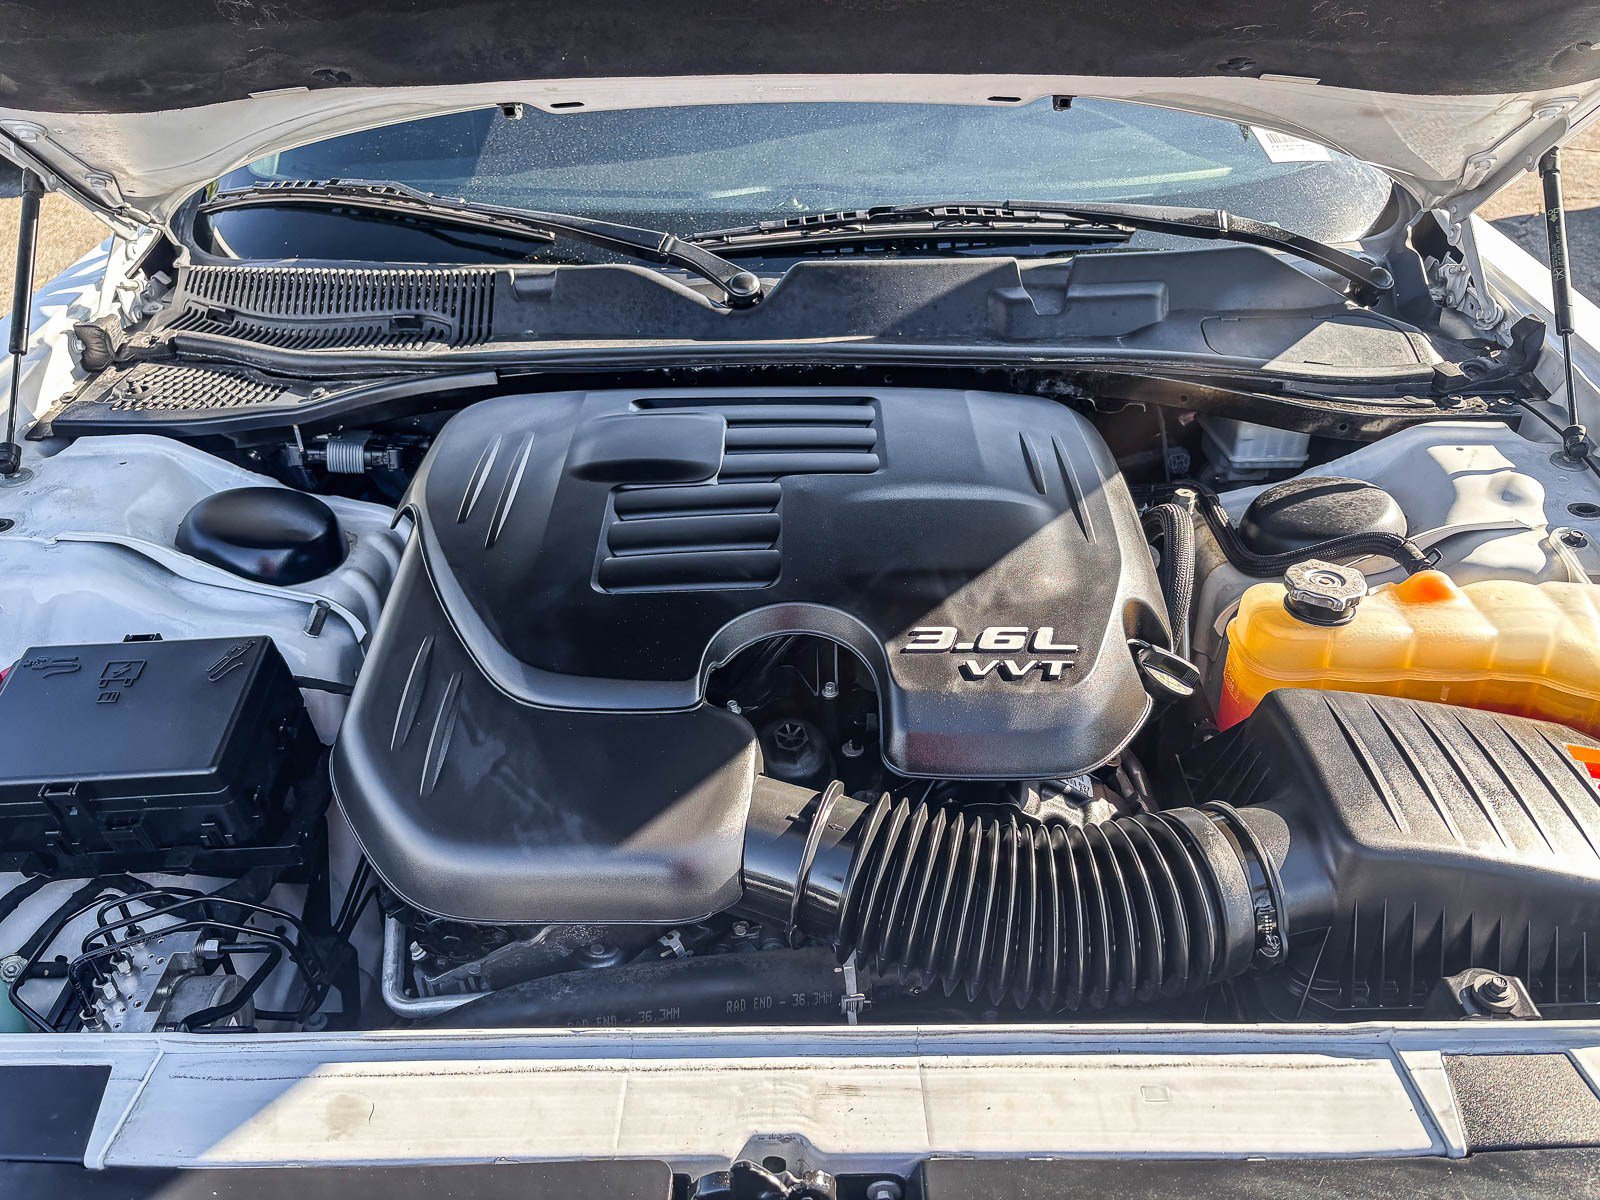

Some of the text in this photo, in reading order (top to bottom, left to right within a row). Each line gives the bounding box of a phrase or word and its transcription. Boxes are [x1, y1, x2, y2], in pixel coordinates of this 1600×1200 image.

[902, 626, 1079, 653] 3.6L
[958, 659, 1075, 681] VVT
[726, 999, 746, 1014] RAD
[753, 996, 773, 1010] END
[637, 1007, 681, 1024] 36.3MM
